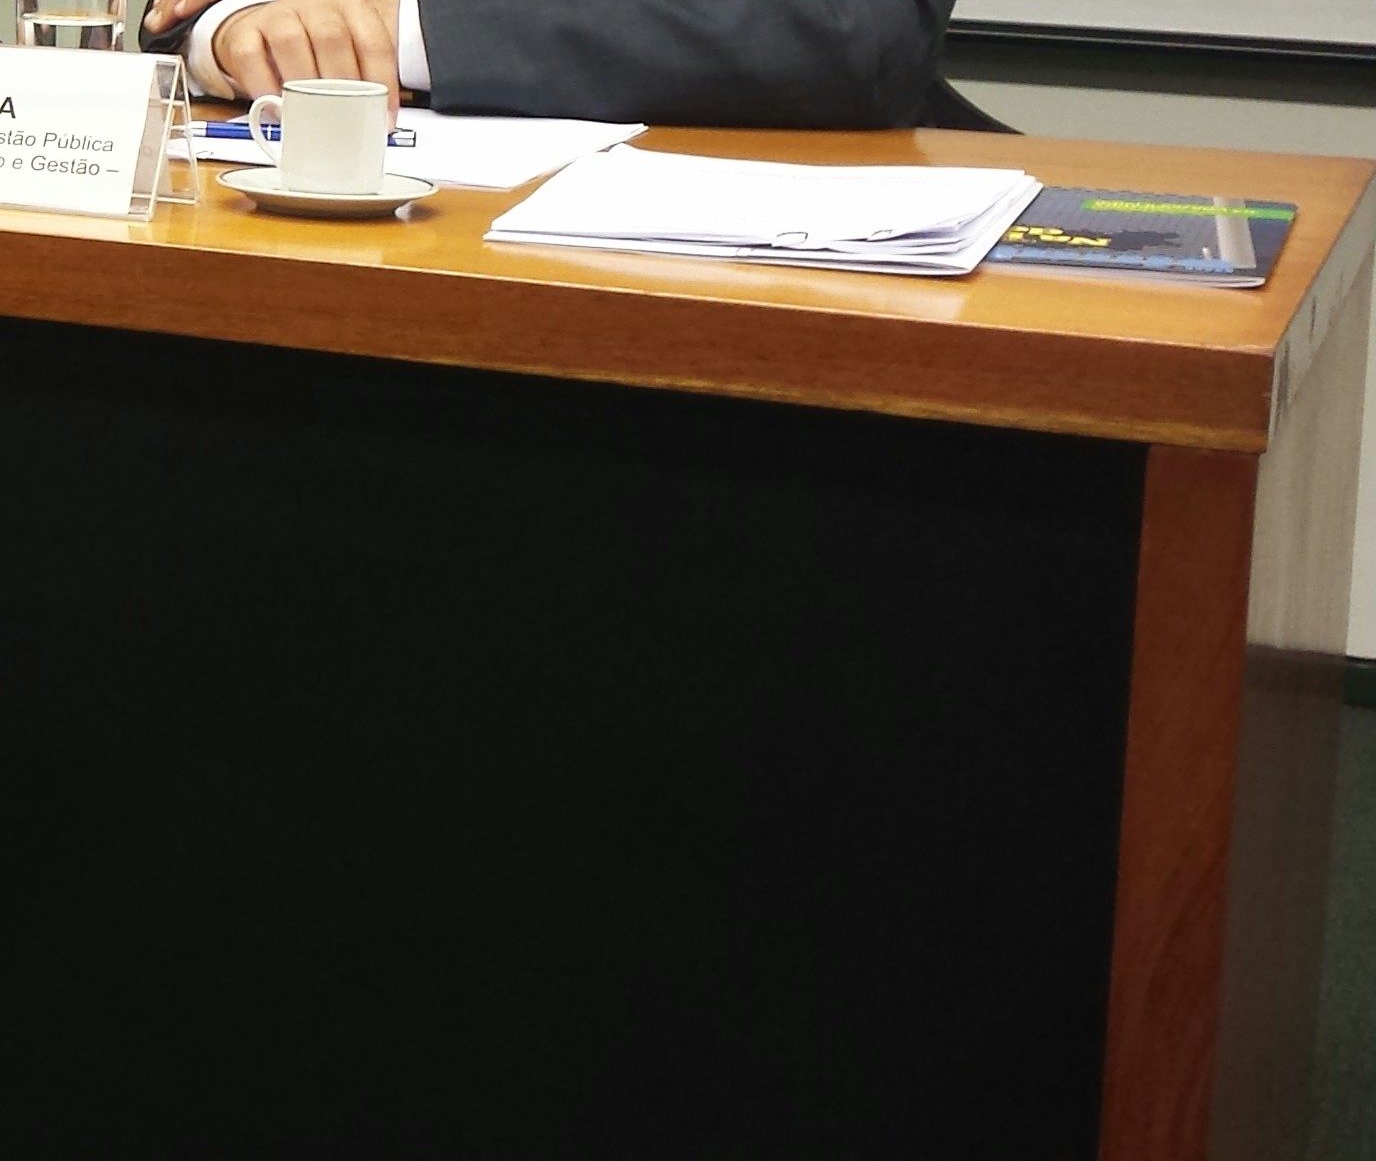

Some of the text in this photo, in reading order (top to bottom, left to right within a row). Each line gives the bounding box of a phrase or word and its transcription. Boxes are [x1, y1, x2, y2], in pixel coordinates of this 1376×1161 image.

[42, 132, 113, 151] Pública
[11, 157, 22, 169] e
[30, 155, 99, 175] Gestão
